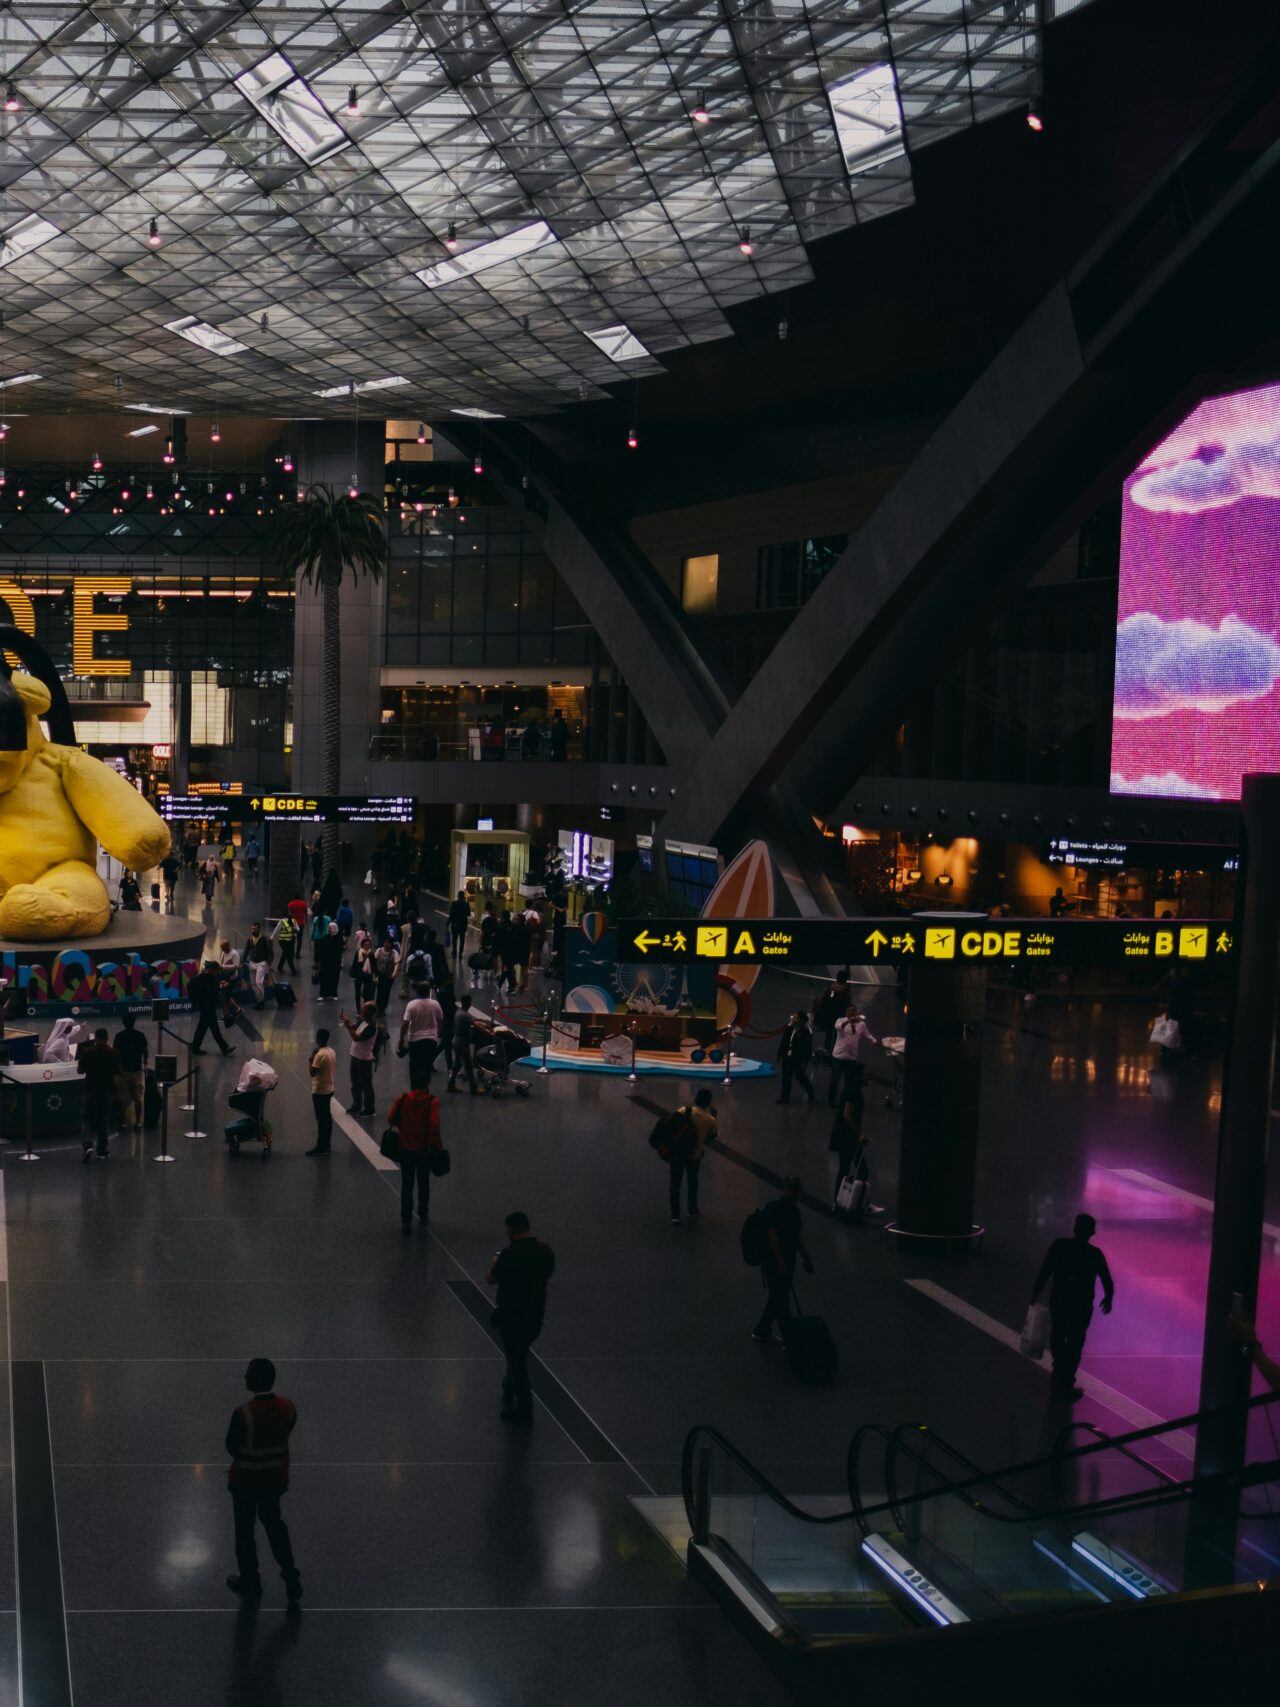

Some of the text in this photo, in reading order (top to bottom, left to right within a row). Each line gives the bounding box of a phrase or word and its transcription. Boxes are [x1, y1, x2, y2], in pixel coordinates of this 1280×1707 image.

[277, 799, 304, 810] CDE
[1075, 856, 1099, 864] Lounges
[664, 934, 671, 942] 3
[733, 931, 756, 954] A
[763, 932, 792, 944] بوابات
[891, 936, 902, 944] 10
[1027, 933, 1054, 944] بوابات
[1123, 932, 1150, 944] بوابات
[1155, 931, 1173, 955] B
[961, 932, 1021, 956] CDE
[762, 946, 788, 955] Gates
[1026, 947, 1051, 955] Gates
[1125, 947, 1149, 955] Gates
